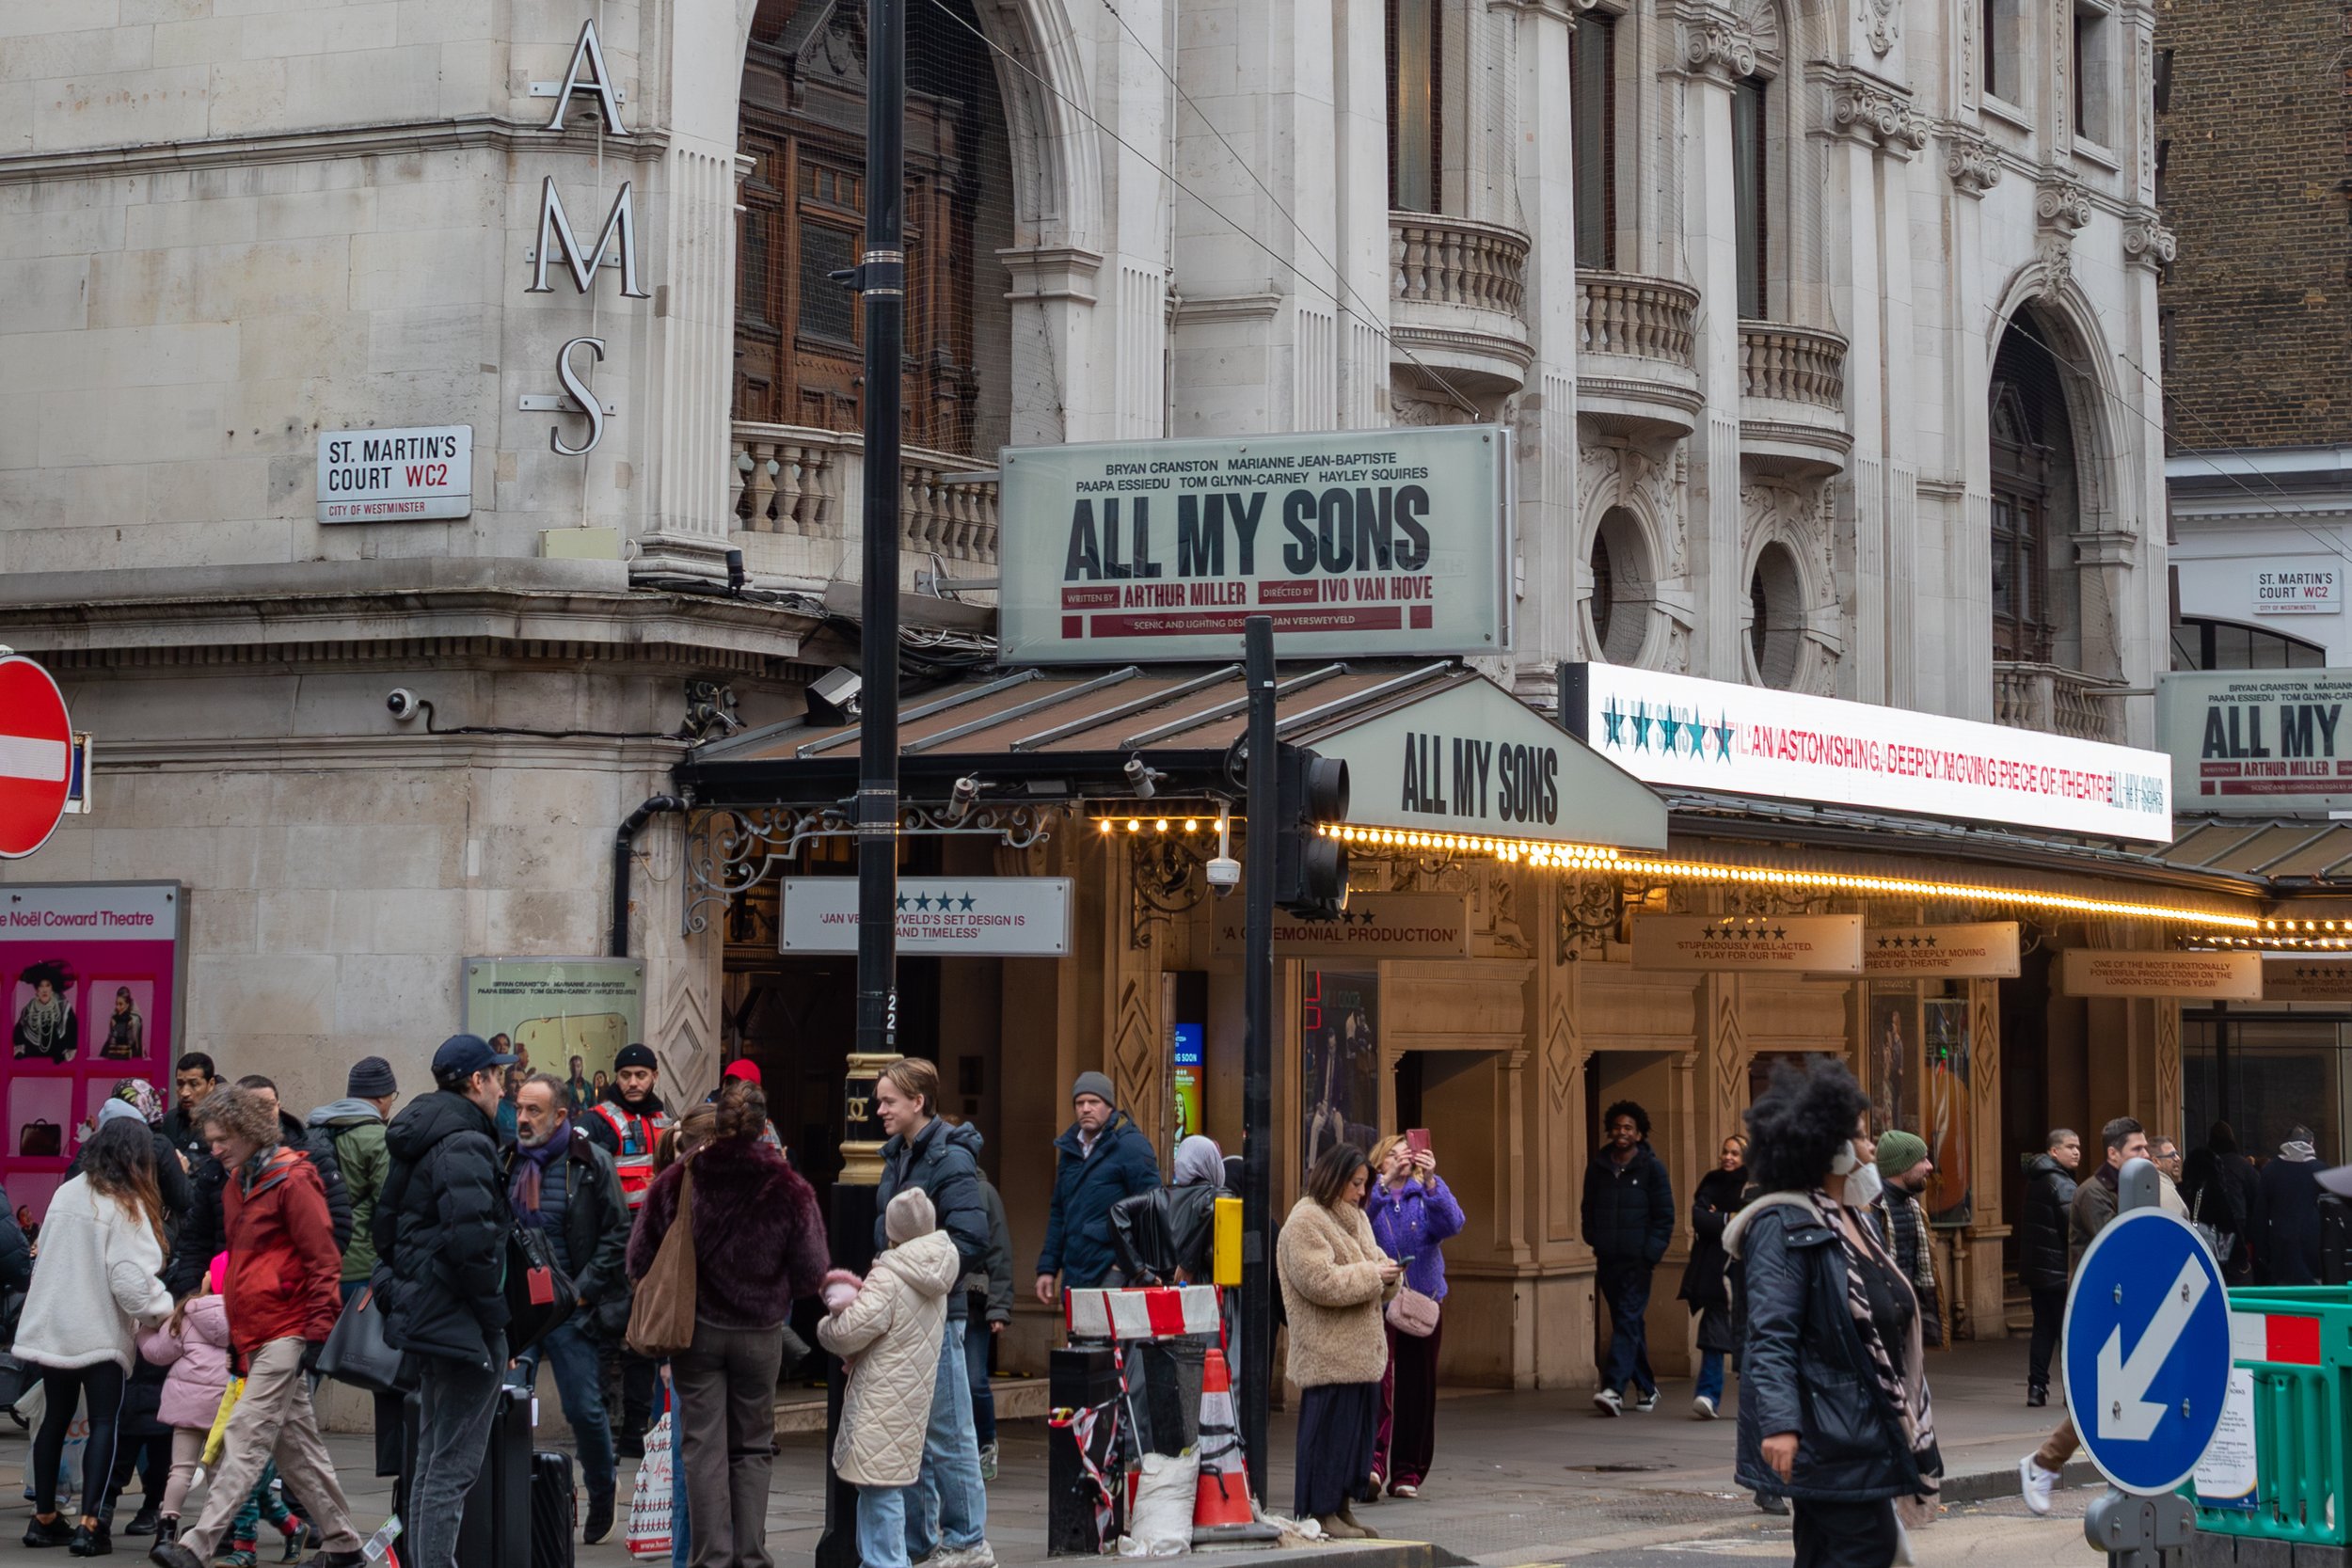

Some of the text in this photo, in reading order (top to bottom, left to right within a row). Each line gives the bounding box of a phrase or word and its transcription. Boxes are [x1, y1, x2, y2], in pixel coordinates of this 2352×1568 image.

[329, 436, 456, 464] ST. MARTIN'S
[1105, 452, 1397, 476] BRYAN CRANSTON MARIANNE JEAN-BAPTISTE
[329, 464, 448, 491] COURT WC2
[1076, 467, 1428, 493] PAAPA ESSIEDU TOM GLYNN-CARNEY HAYLEY SQUIRES
[329, 502, 425, 516] CITY OF WESTMINSTER
[1064, 484, 1431, 581] ALL MY SONS
[2259, 572, 2332, 585] ST. MARTIN'S
[1067, 576, 1433, 609] WRITTEN BY ARTHUR MILLER DIRECTED BY IVO VAN HOVE
[2260, 586, 2328, 598] COURT WC2
[1134, 621, 1165, 630] SCENIC
[1166, 620, 1184, 629] AND
[1186, 618, 1226, 628] LIGHTING
[1273, 617, 1291, 626] JAN
[1293, 615, 1355, 625] VERSWEYVELD
[2230, 684, 2258, 692] BRYAN
[2260, 683, 2308, 692] CRANSTON
[2208, 694, 2236, 703] PAAPA
[2237, 693, 2275, 702] ESSIEDU
[2201, 704, 2343, 758] ALL MY
[1887, 743, 1941, 779] DEEPLY
[1943, 752, 1996, 787] MOVING
[1999, 759, 2037, 792] PIECE
[2244, 761, 2287, 777] ARTHUR
[2290, 760, 2329, 776] MILLER
[1401, 732, 1558, 826] ALL MY SONS
[10, 911, 41, 927] Noël
[44, 911, 97, 927] Coward
[101, 911, 154, 927] Theatre
[944, 914, 963, 926] SET
[968, 914, 1011, 927] DESIGN
[1014, 915, 1025, 926] IS
[895, 927, 980, 939] AND TIMELESS'
[1347, 927, 1458, 942] PRODUCTION'
[1749, 952, 1769, 960] OUR
[1911, 948, 1947, 958] DEEPLY
[1948, 948, 1986, 958] MOVING
[1865, 959, 1892, 969] PIECE
[1894, 959, 1907, 968] OF
[2145, 961, 2169, 970] MOST
[2172, 962, 2231, 971] EMOTIONALLY
[2137, 970, 2199, 978] PRODUCTIONS
[2143, 978, 2169, 987] STAGE
[1181, 1053, 1197, 1062] SOON
